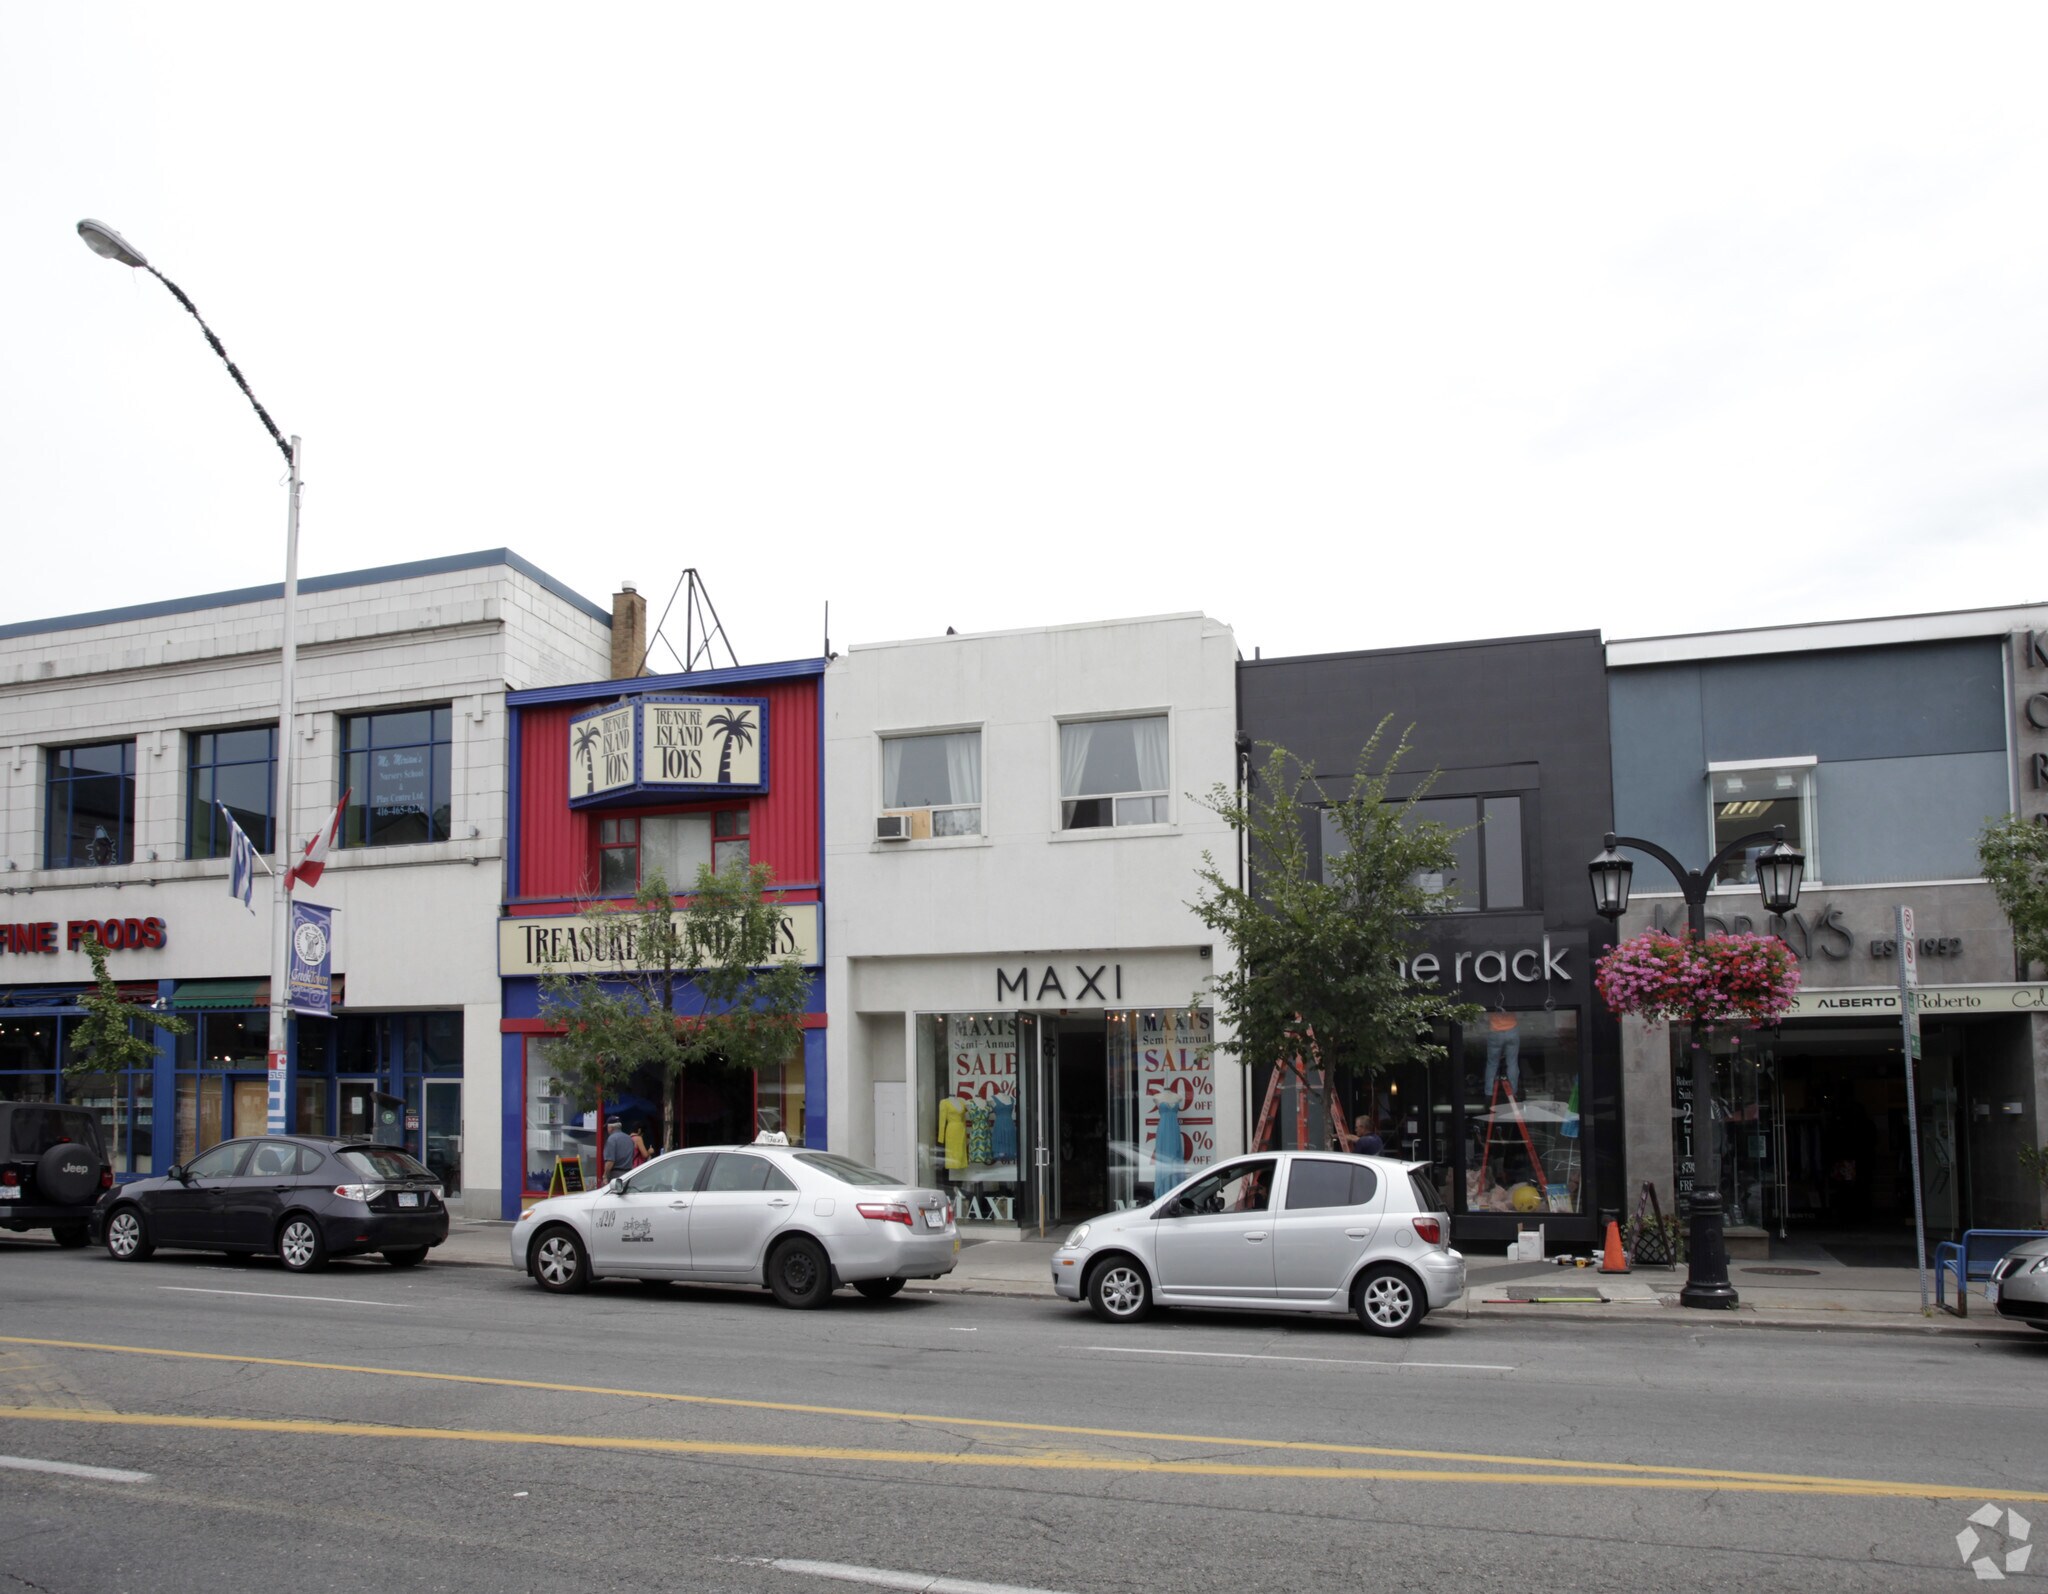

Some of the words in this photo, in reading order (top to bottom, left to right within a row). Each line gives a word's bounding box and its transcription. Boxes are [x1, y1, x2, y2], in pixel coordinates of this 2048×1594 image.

[601, 711, 630, 734] TREASURE
[653, 708, 703, 725] TREASURE
[603, 728, 630, 755] ISLAND
[656, 725, 703, 747] ISLAND
[602, 752, 630, 786] TOYS
[653, 746, 703, 779] TOYS
[67, 916, 167, 951] FOODS
[518, 923, 639, 964] TREASURE
[1869, 938, 1900, 956] ES
[1918, 935, 1965, 955] 1952
[1455, 934, 1572, 983] rack
[996, 964, 1122, 1002] MAXI
[1817, 997, 1896, 1009] ALBERTO
[1916, 993, 1981, 1009] Roberto
[955, 1018, 1016, 1036] MAXI'S
[1143, 1012, 1210, 1032] MAXI'S
[954, 1040, 1016, 1049] Semi-Annua
[956, 1053, 1017, 1076] SALE
[1144, 1048, 1211, 1073] SALE
[1145, 1075, 1213, 1114] 50%
[1194, 1101, 1213, 1110] OFF
[1683, 1103, 1692, 1124] 2
[1684, 1136, 1692, 1157] 1
[62, 1162, 89, 1174] Jeep
[1193, 1155, 1212, 1165] OFF
